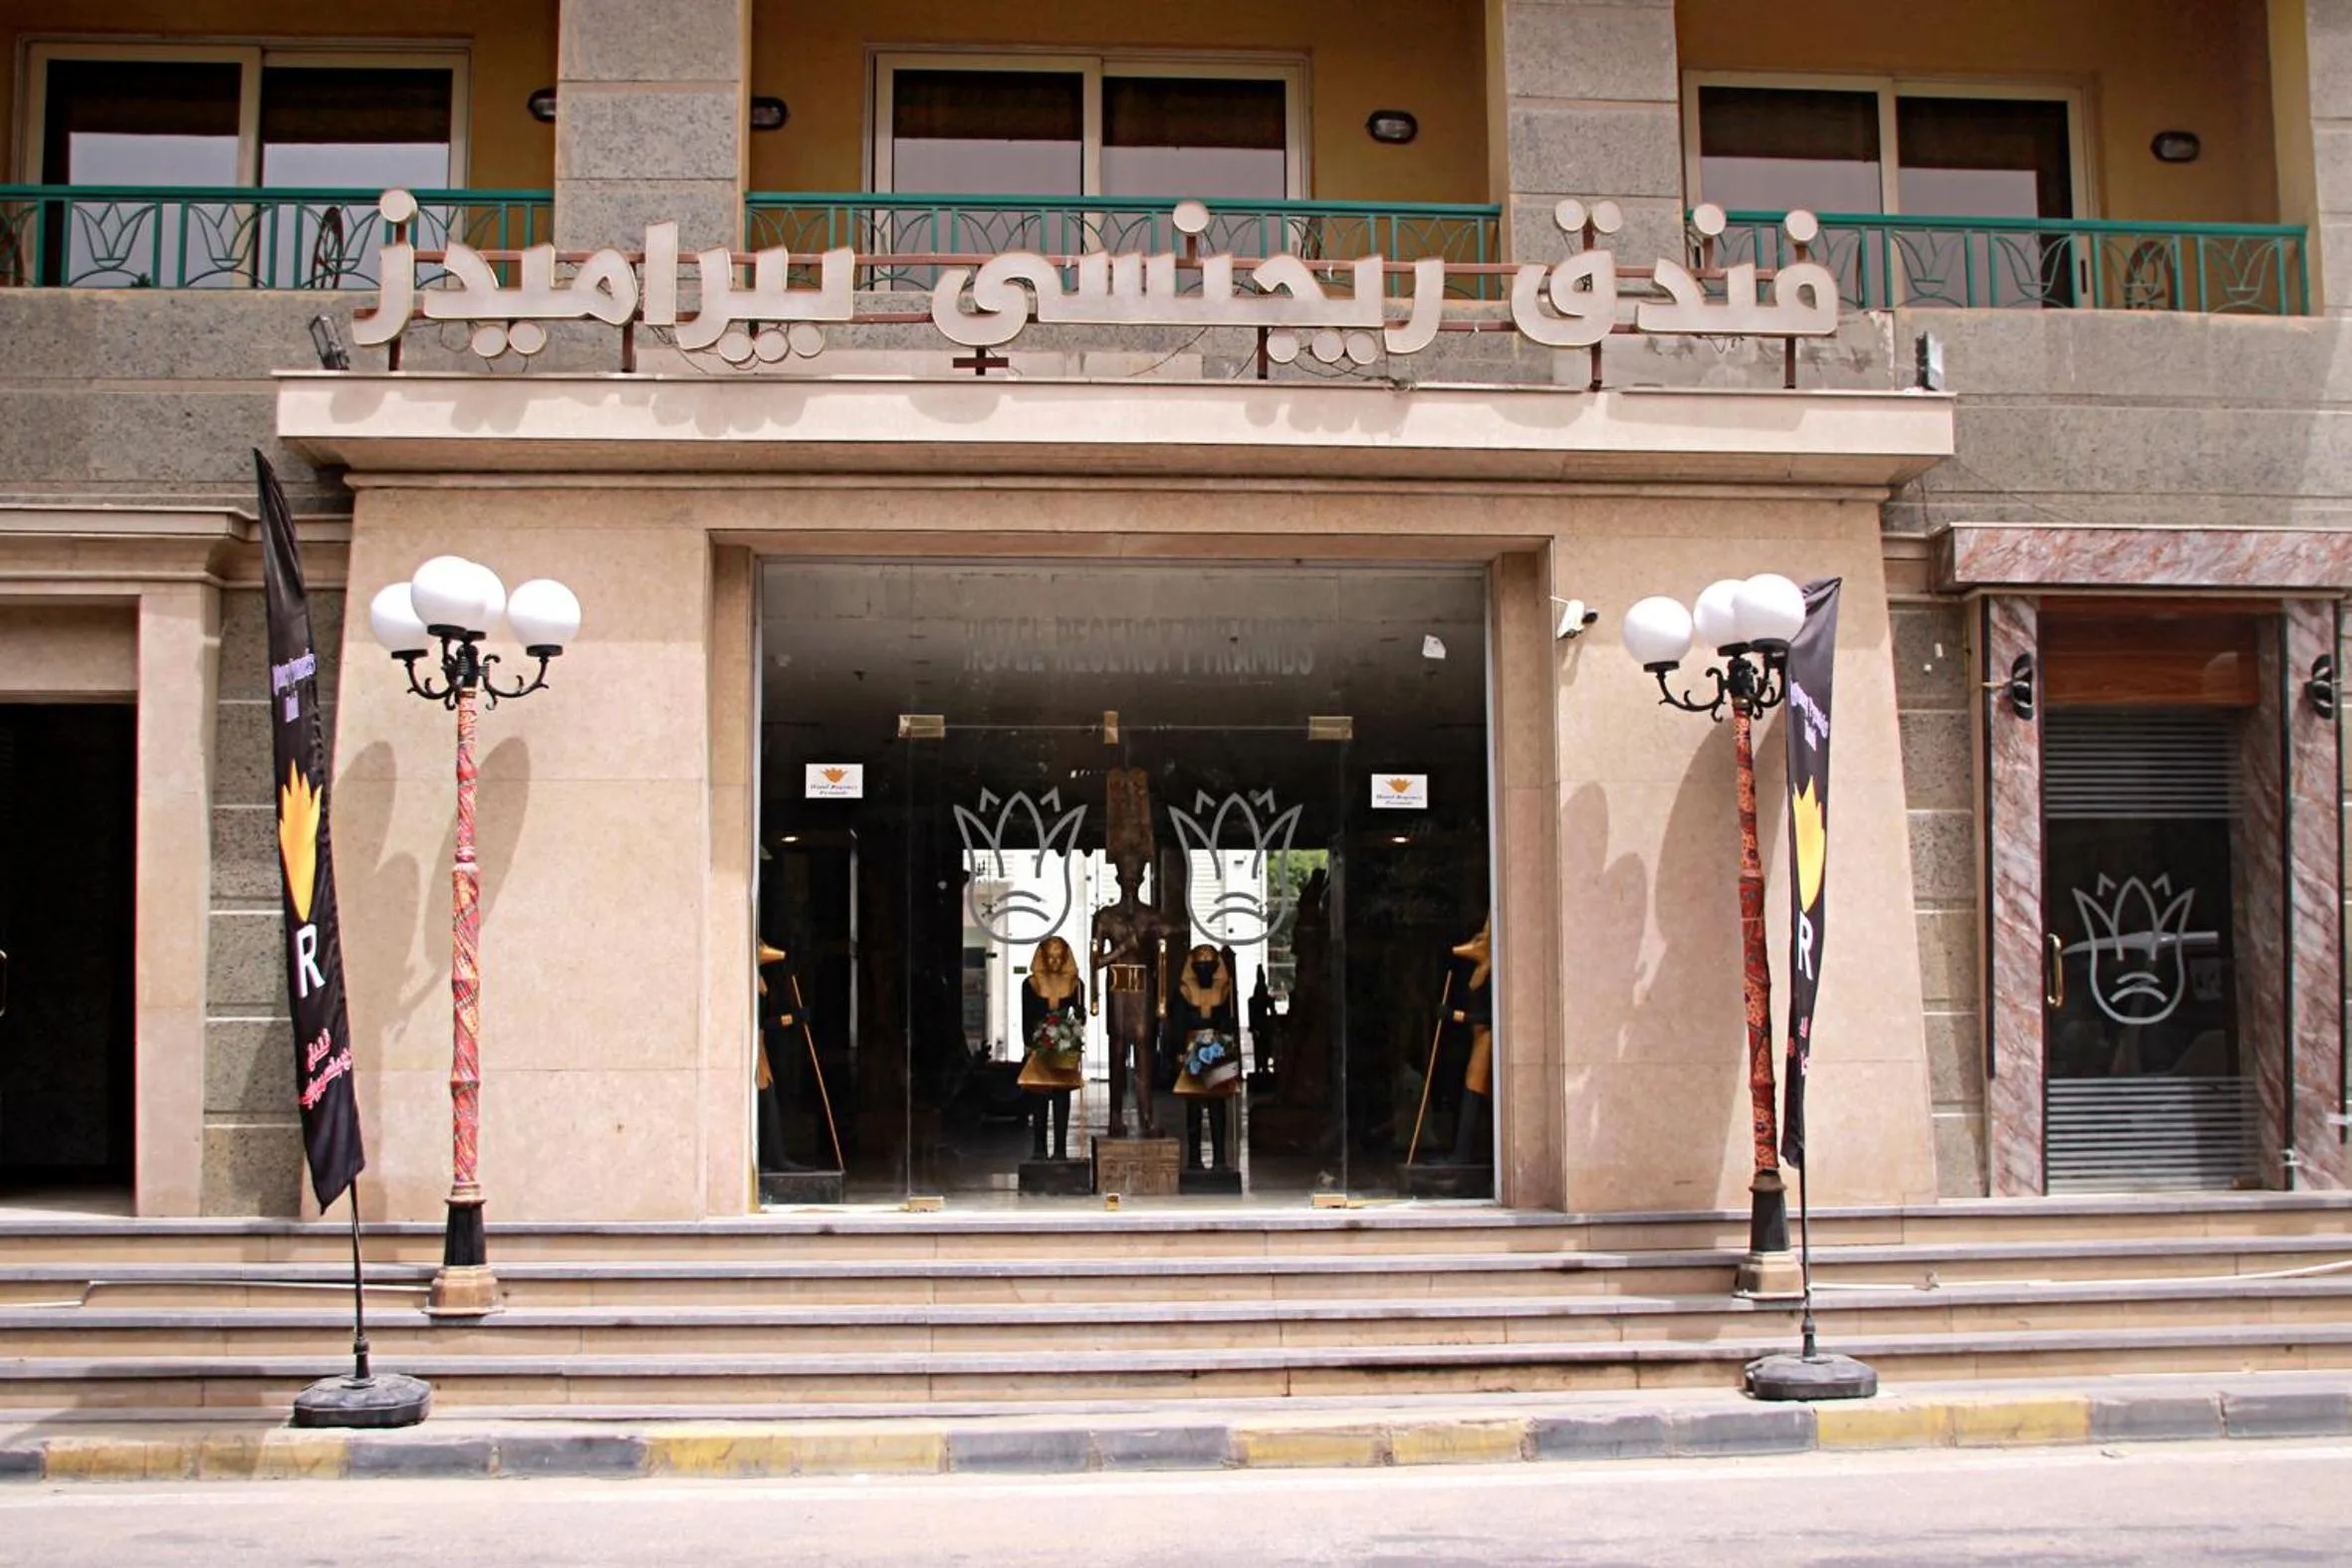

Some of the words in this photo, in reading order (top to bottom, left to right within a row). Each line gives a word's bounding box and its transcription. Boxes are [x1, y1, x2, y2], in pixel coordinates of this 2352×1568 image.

[352, 189, 854, 362] بيراميدز
[1511, 198, 1840, 348] فندق
[296, 924, 326, 998] R
[1797, 911, 1813, 980] R
